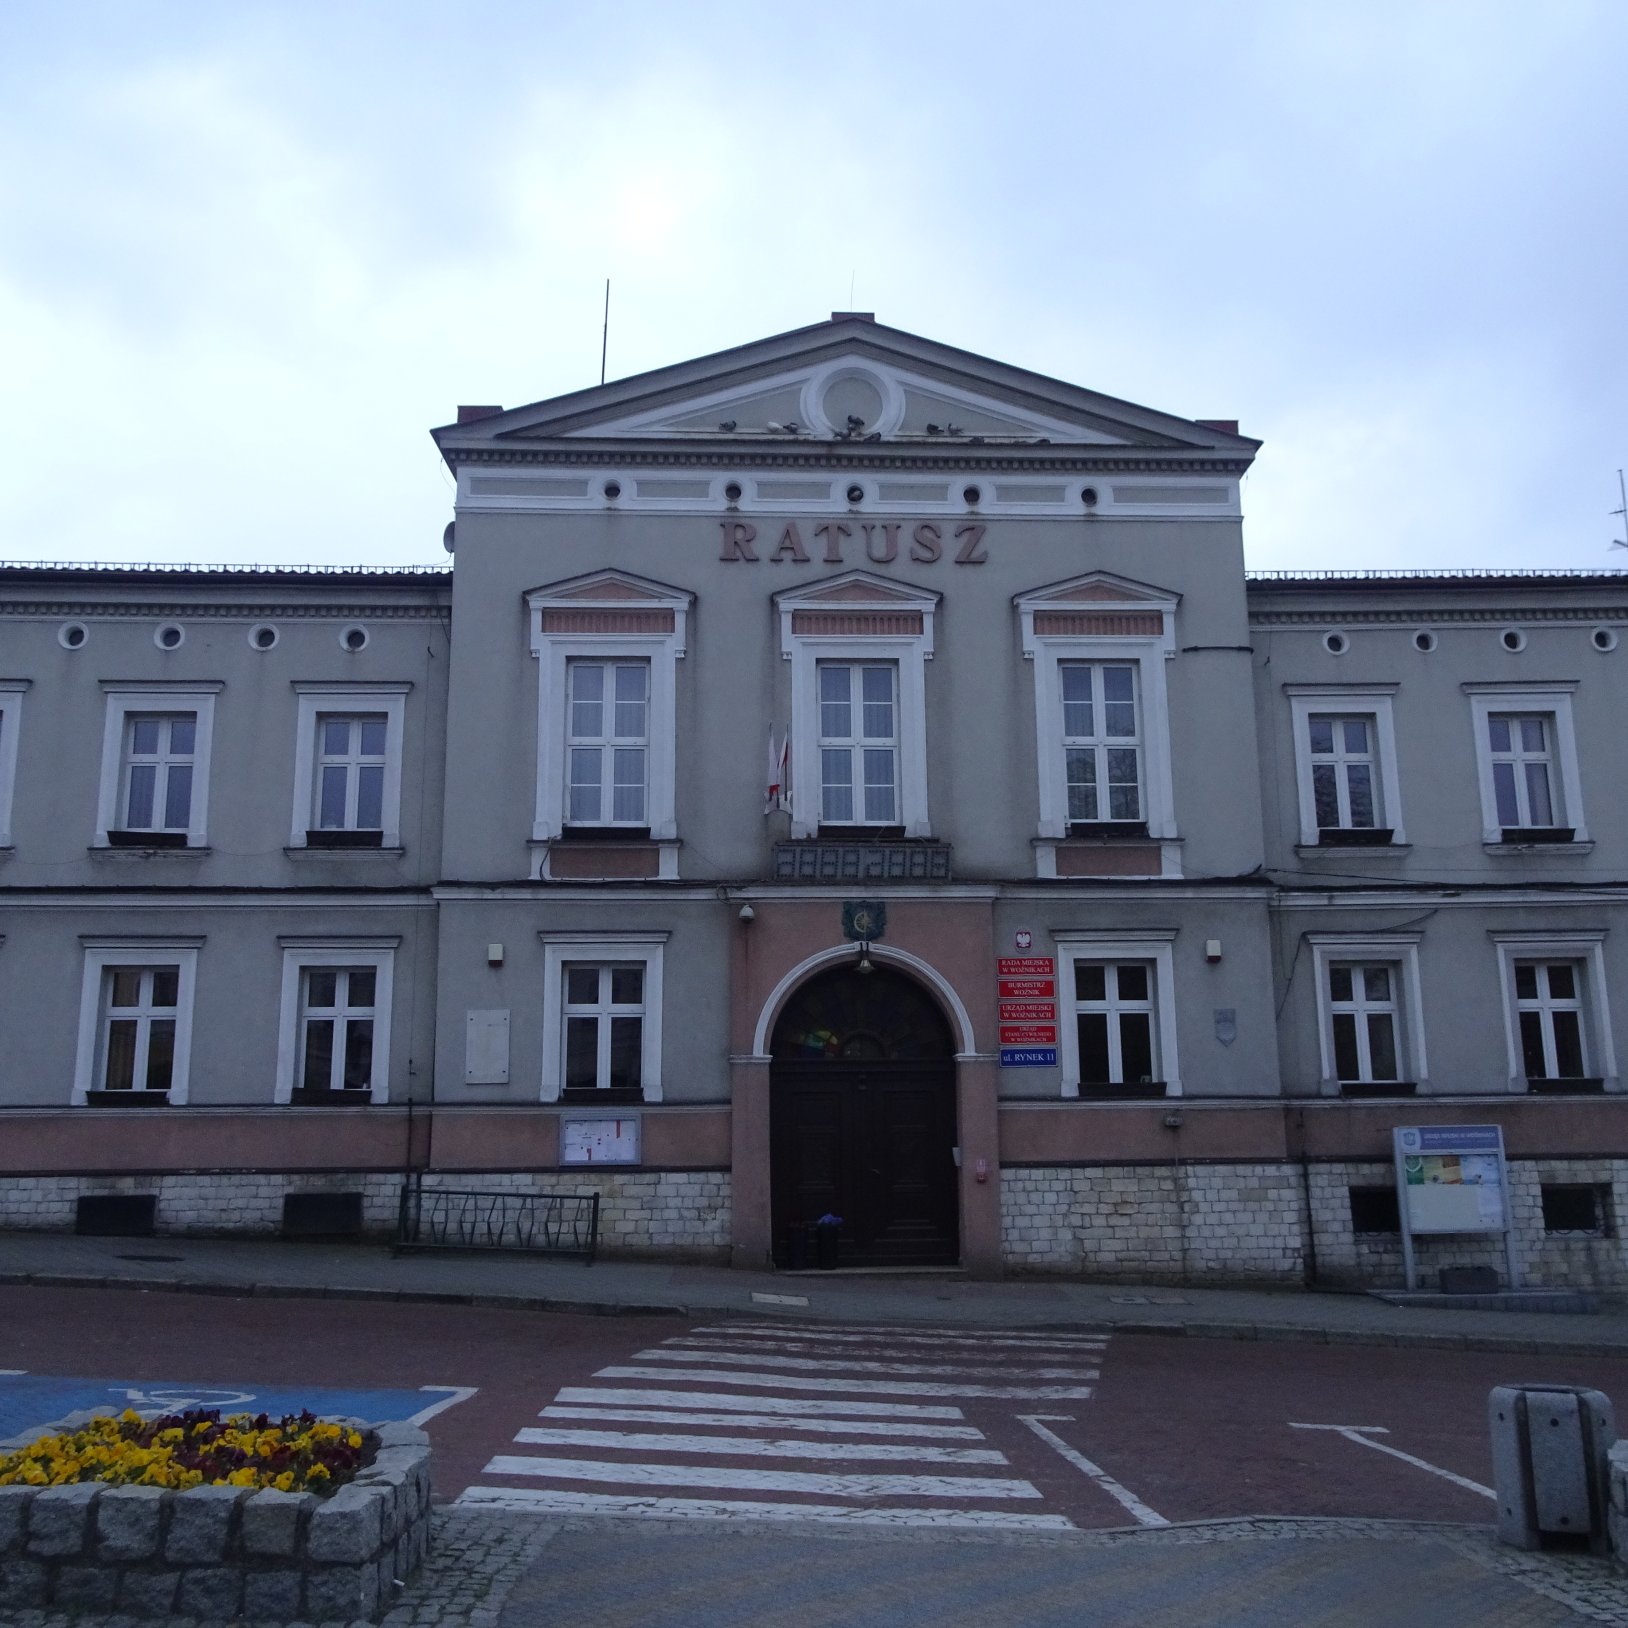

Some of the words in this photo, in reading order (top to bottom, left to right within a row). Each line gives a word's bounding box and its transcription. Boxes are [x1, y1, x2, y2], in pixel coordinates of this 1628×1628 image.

[719, 521, 989, 563] RATUSZ
[1003, 1053, 1013, 1062] ul.
[1014, 1053, 1045, 1061] RYNEK
[1046, 1053, 1054, 1061] 11
